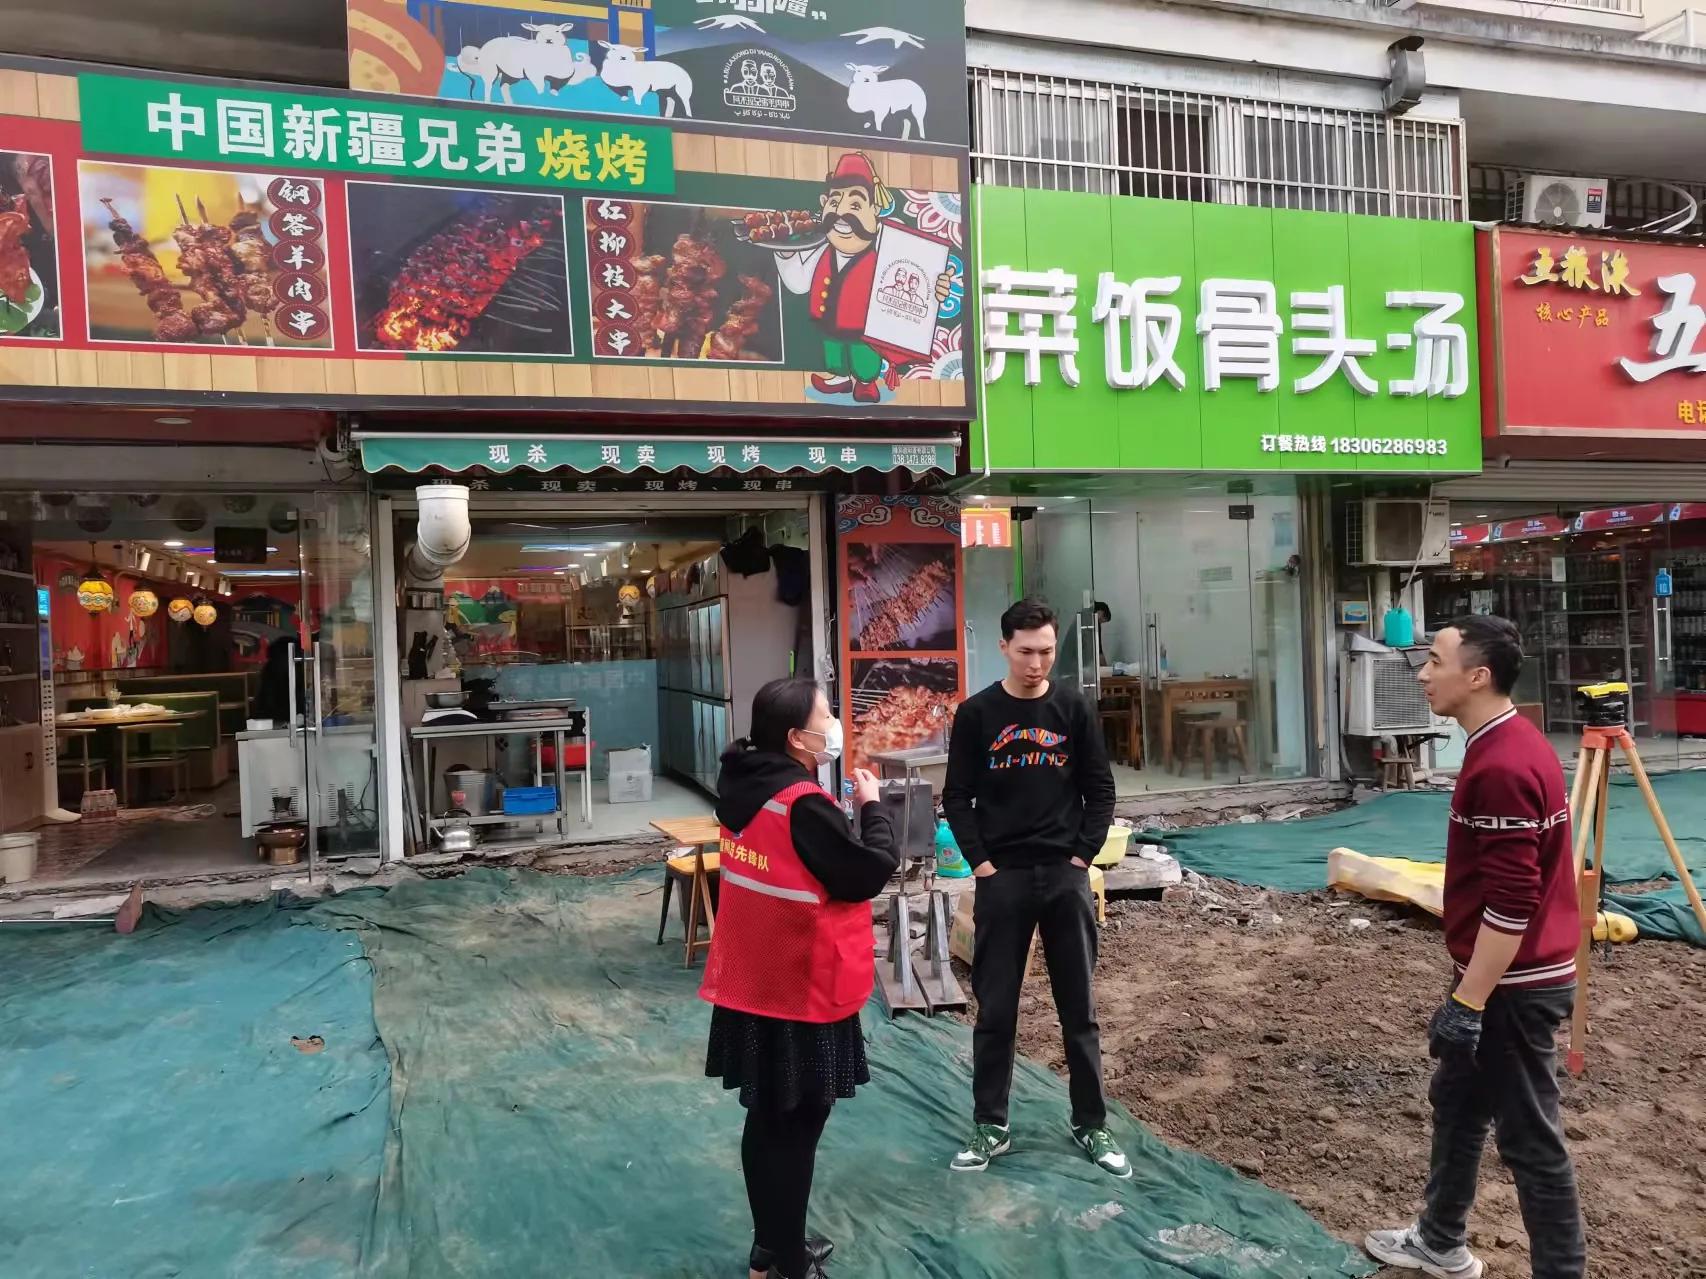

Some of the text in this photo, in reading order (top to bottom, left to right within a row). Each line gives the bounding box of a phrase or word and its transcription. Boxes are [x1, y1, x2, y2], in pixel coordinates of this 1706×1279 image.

[147, 92, 648, 186] 中国新疆兄弟烧烤
[597, 199, 633, 355] 红柳枝大串
[1536, 303, 1609, 328] 核心产品
[983, 264, 1469, 398] 菜饭骨头汤
[1611, 272, 1706, 382] 五
[488, 444, 857, 464] 现杀 现卖 现烤 现串
[1261, 434, 1448, 455] 订餐热线 18306286983
